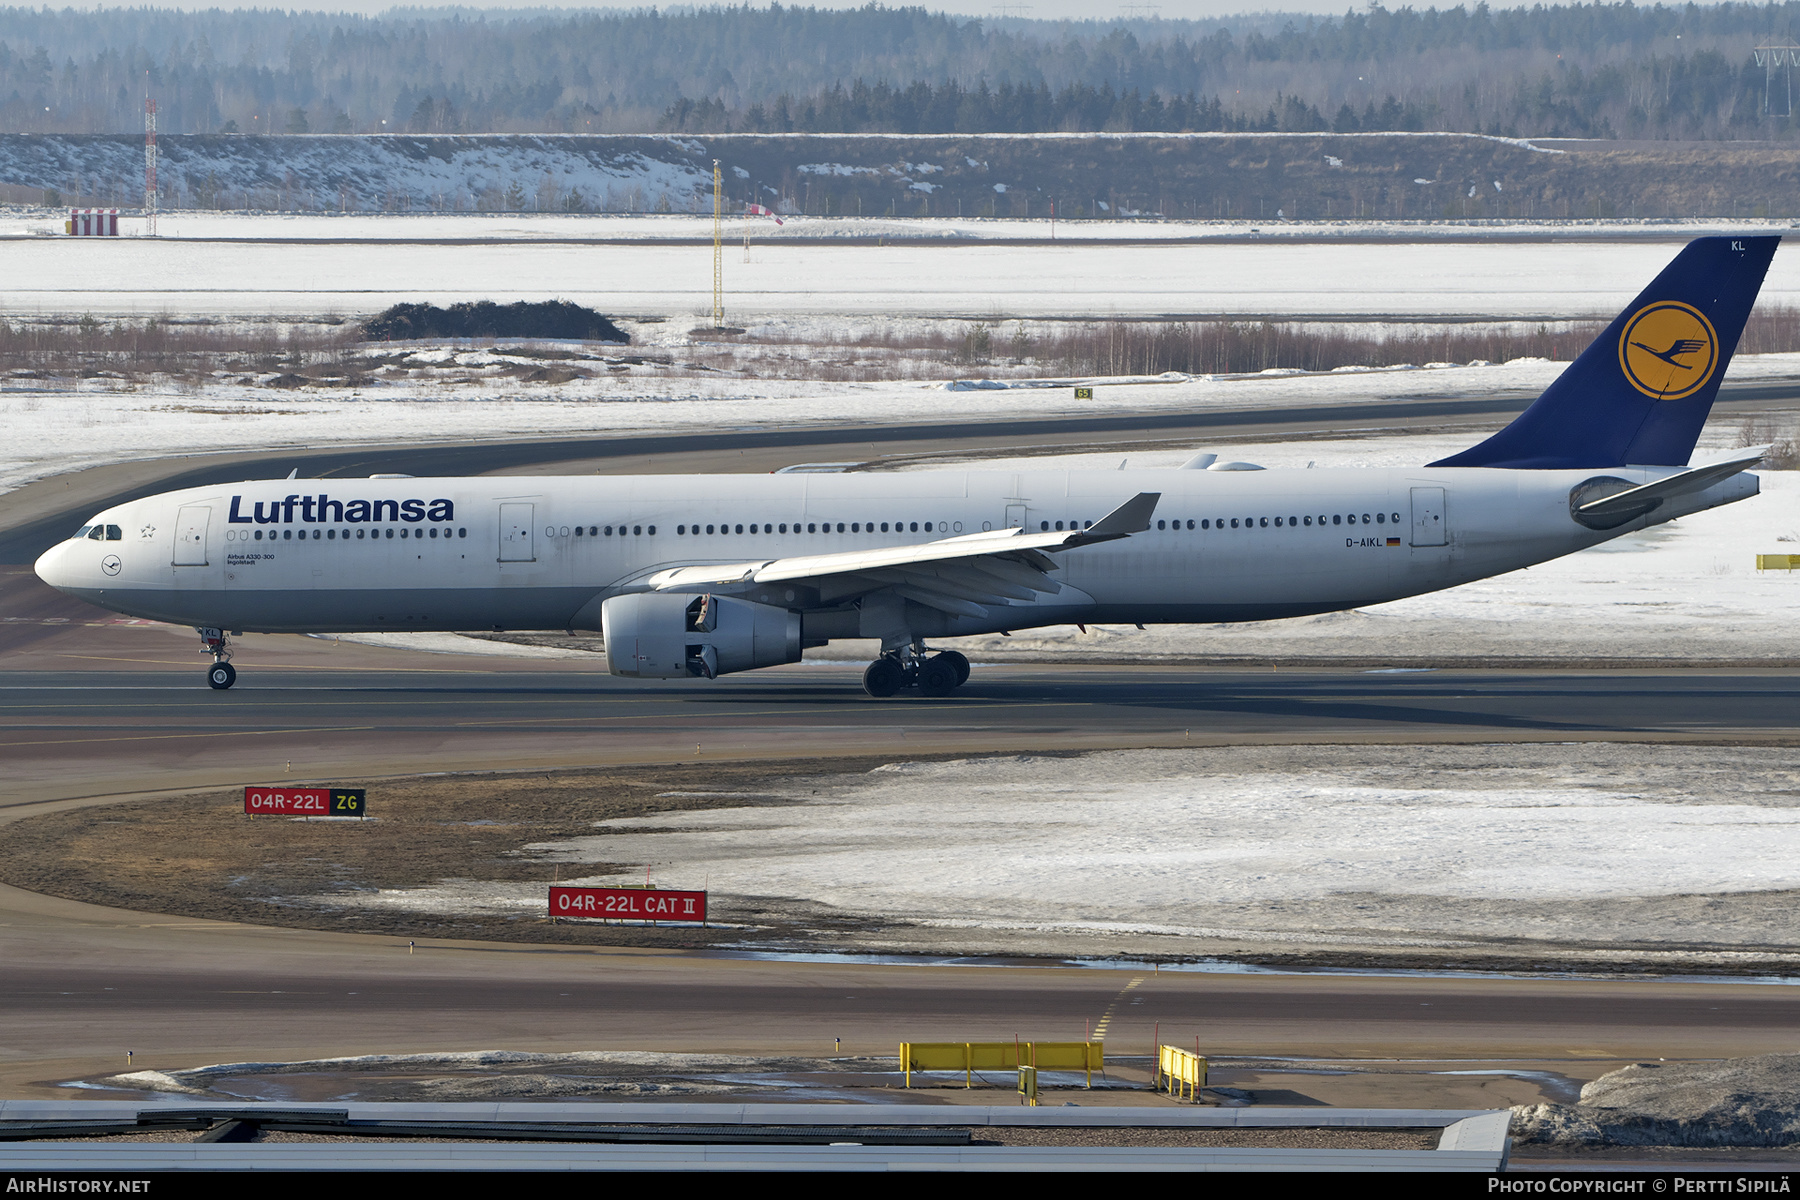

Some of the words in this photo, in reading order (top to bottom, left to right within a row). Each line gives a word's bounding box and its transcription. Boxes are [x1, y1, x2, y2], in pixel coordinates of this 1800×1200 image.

[1731, 241, 1745, 251] KL
[229, 495, 454, 525] Lufthansa
[1346, 538, 1383, 547] D-AIKL
[205, 629, 217, 637] KL
[251, 793, 324, 809] 04R-22L
[336, 796, 357, 810] ZG
[558, 895, 640, 912] 04R-22L
[645, 898, 678, 913] CAT
[682, 898, 696, 914] II
